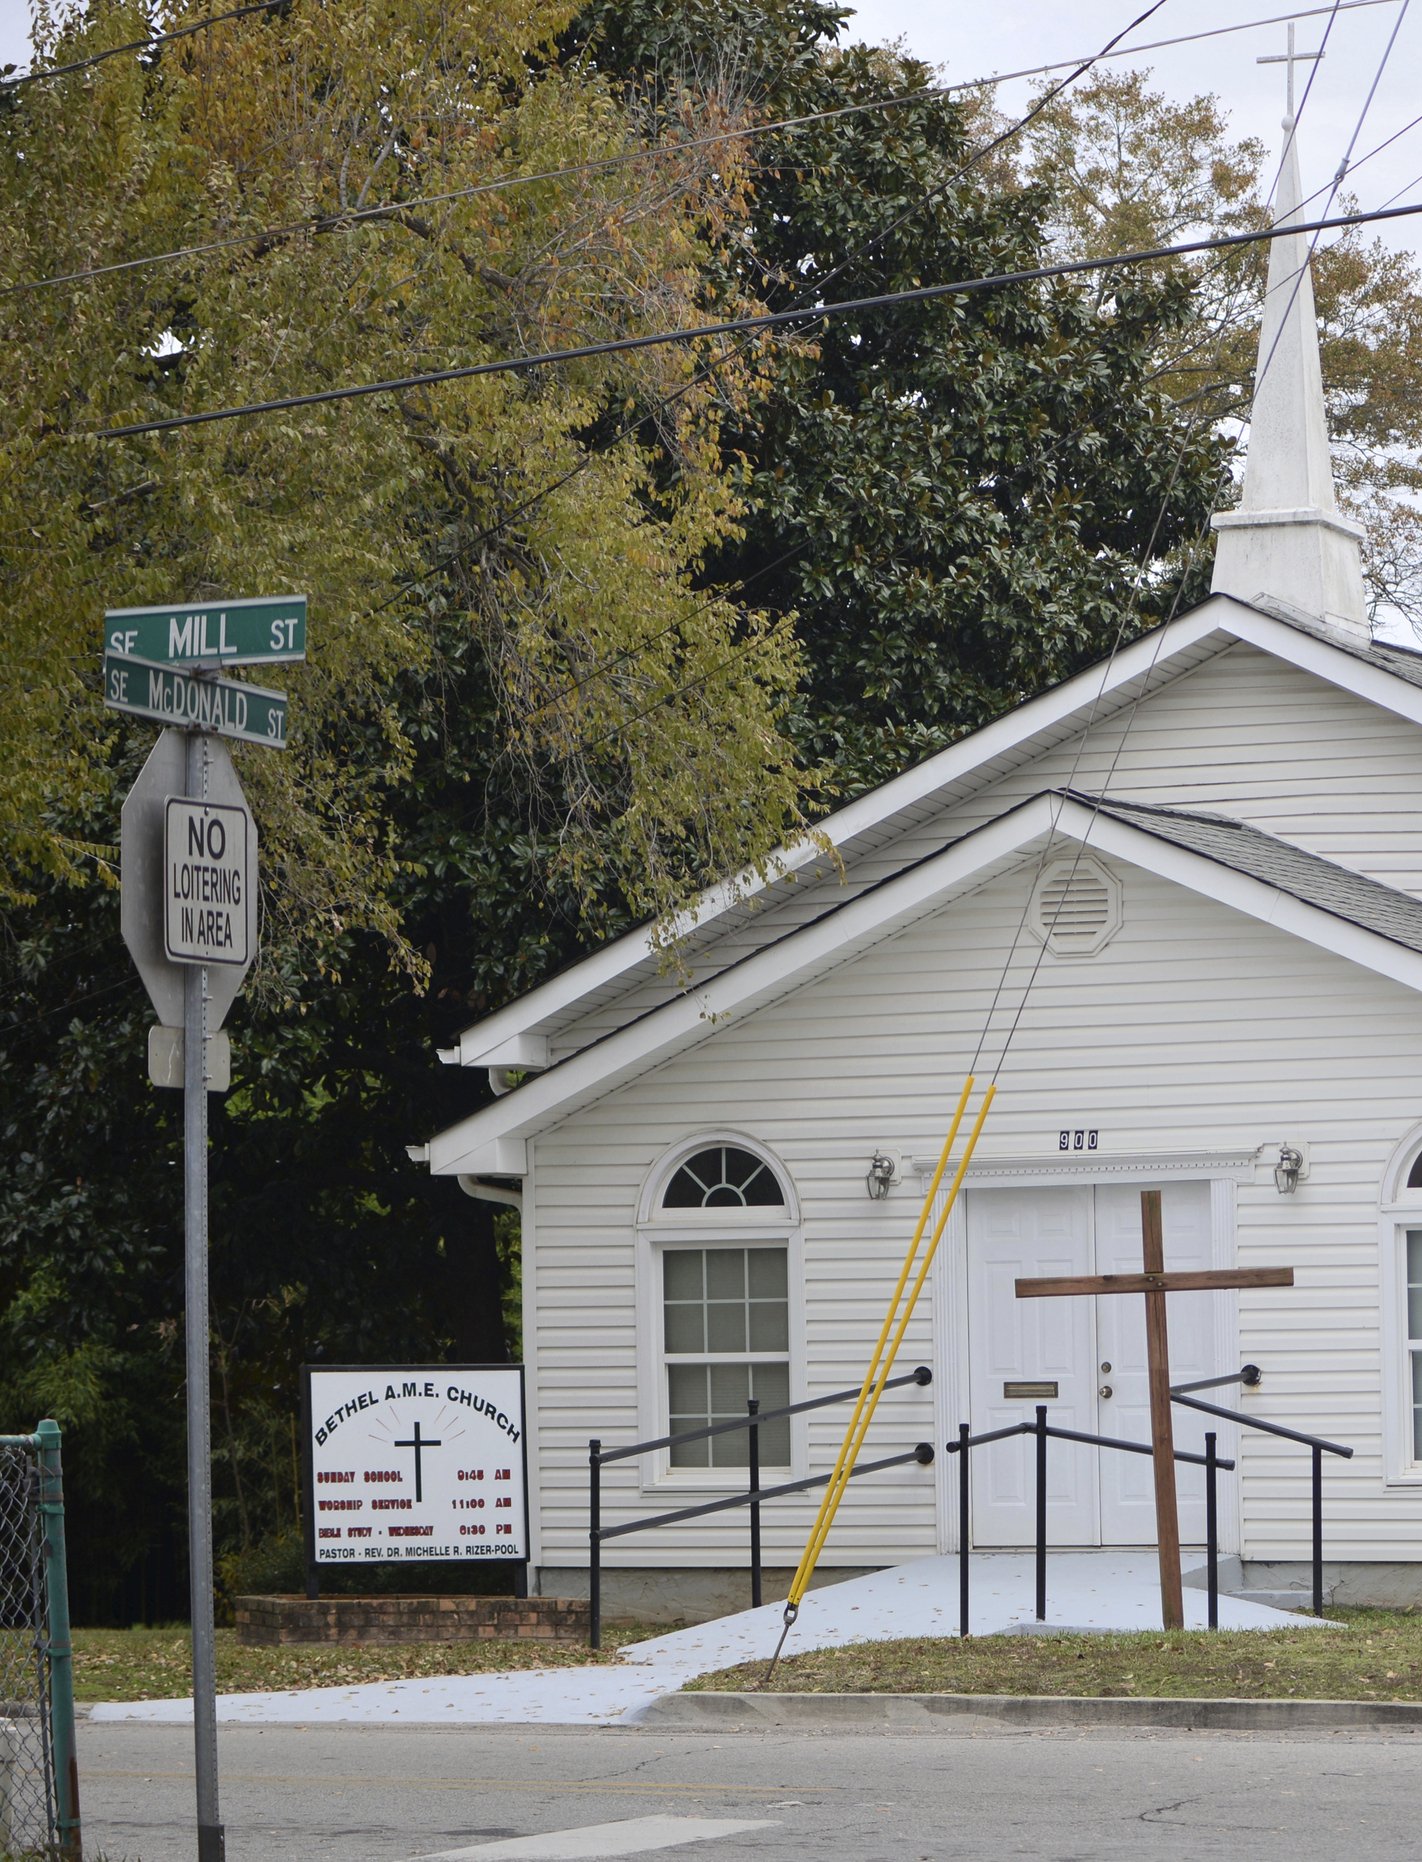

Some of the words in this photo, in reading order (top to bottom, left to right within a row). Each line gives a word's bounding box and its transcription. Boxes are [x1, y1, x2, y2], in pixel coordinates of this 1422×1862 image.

[110, 630, 138, 654] SE
[168, 613, 237, 658] MILL
[270, 618, 298, 651] ST
[110, 669, 129, 703] SE
[149, 669, 248, 732] McDONALD
[267, 708, 284, 740] ST
[188, 815, 226, 860] NO
[173, 863, 241, 905] LOITERING
[181, 906, 194, 943] IN
[197, 910, 233, 948] AREA
[1059, 1130, 1098, 1150] 900
[314, 1391, 379, 1446] BETHEL
[384, 1382, 440, 1401] A.M.E.
[446, 1386, 521, 1443] CHURCH
[317, 1471, 356, 1483] SUNDAY
[363, 1471, 403, 1483] SCHOOL
[457, 1469, 484, 1481] 9:45
[494, 1469, 511, 1480] AM
[318, 1500, 363, 1511] WORSHIP
[371, 1499, 413, 1510] SERVICE
[452, 1498, 485, 1509] 11:00
[495, 1497, 512, 1508] AM
[318, 1527, 341, 1538] BIBLE
[347, 1527, 372, 1538] STUDY
[388, 1525, 434, 1537] WEDNESDAY
[459, 1524, 486, 1535] 6:30
[495, 1524, 512, 1534] PM
[319, 1548, 355, 1559] PASTOR
[364, 1547, 384, 1558] REV.
[387, 1547, 403, 1557] DR.
[405, 1546, 450, 1557] MICHELLE
[453, 1546, 463, 1556] R.
[465, 1544, 519, 1556] RIZER-POOL
